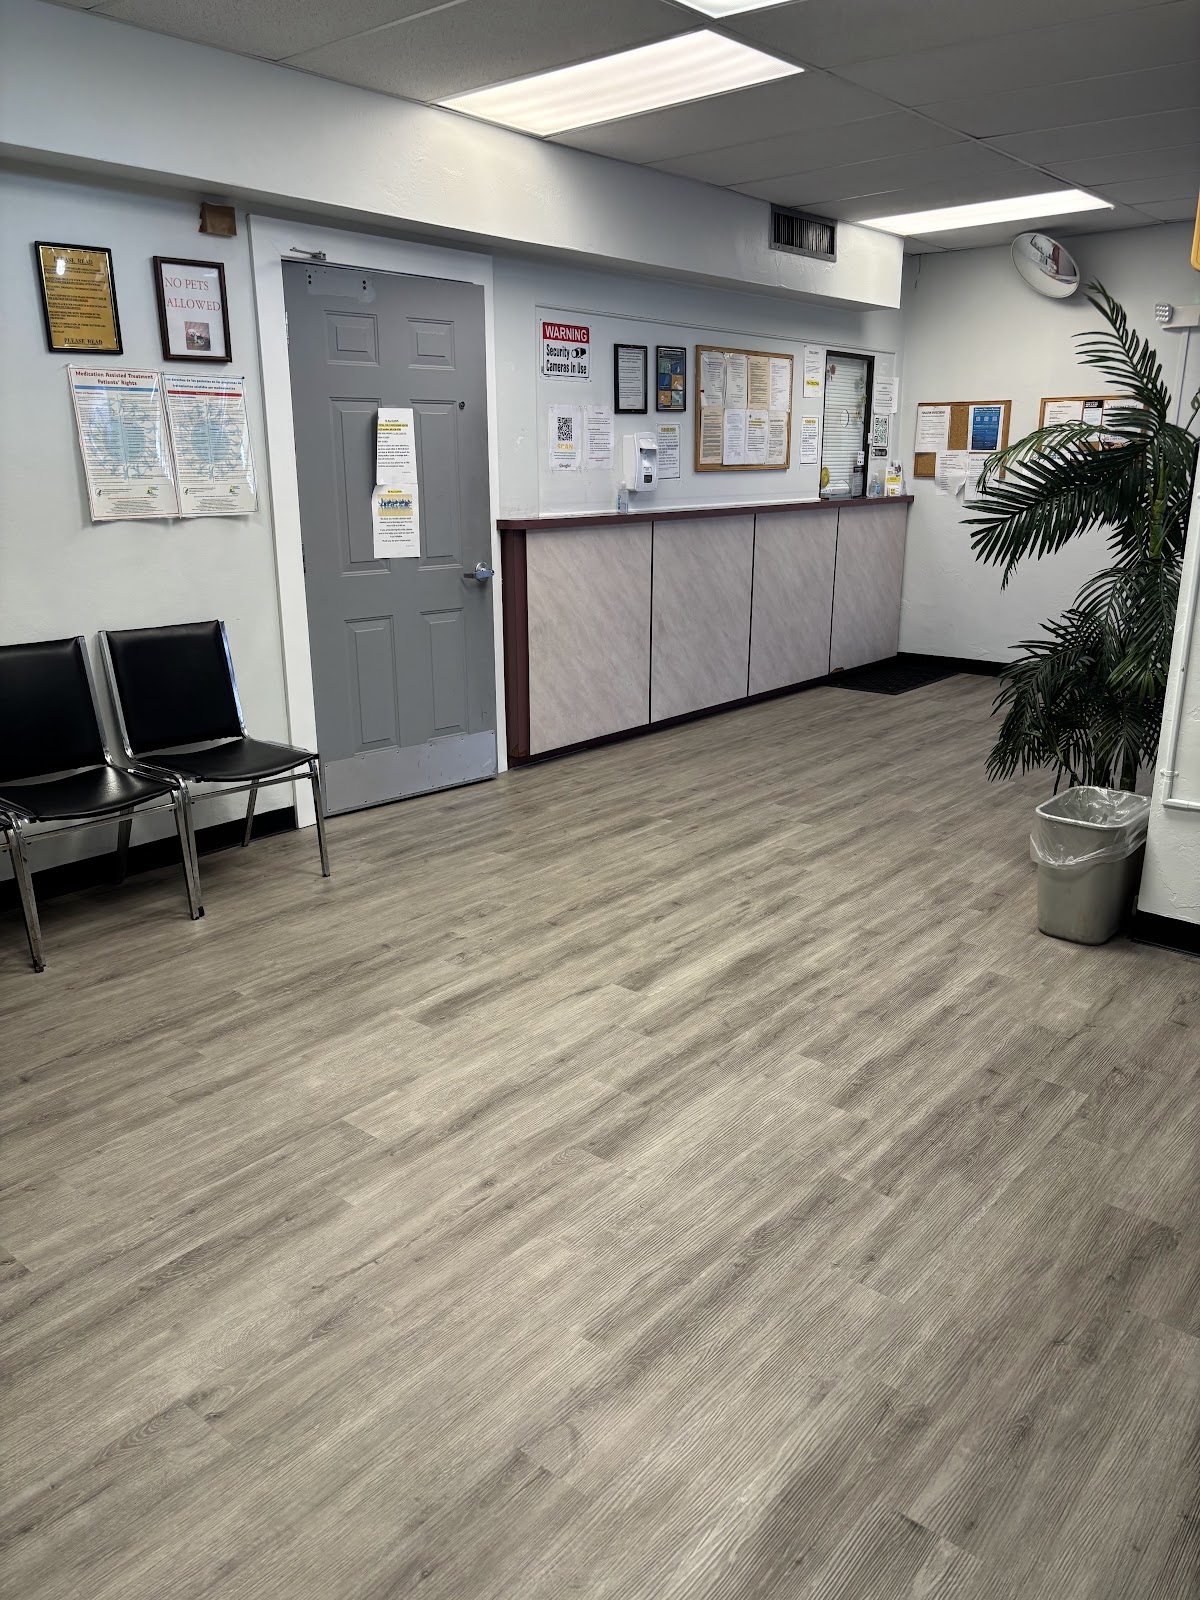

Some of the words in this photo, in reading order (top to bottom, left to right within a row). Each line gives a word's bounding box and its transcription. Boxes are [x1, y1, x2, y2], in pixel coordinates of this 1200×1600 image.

[165, 277, 182, 288] NO
[185, 280, 208, 290] PETS
[167, 298, 220, 311] ALLOWED
[545, 325, 588, 342] WARNING
[546, 344, 570, 360] Security
[546, 360, 570, 373] Cameras
[570, 362, 577, 374] In
[578, 362, 586, 374] Use
